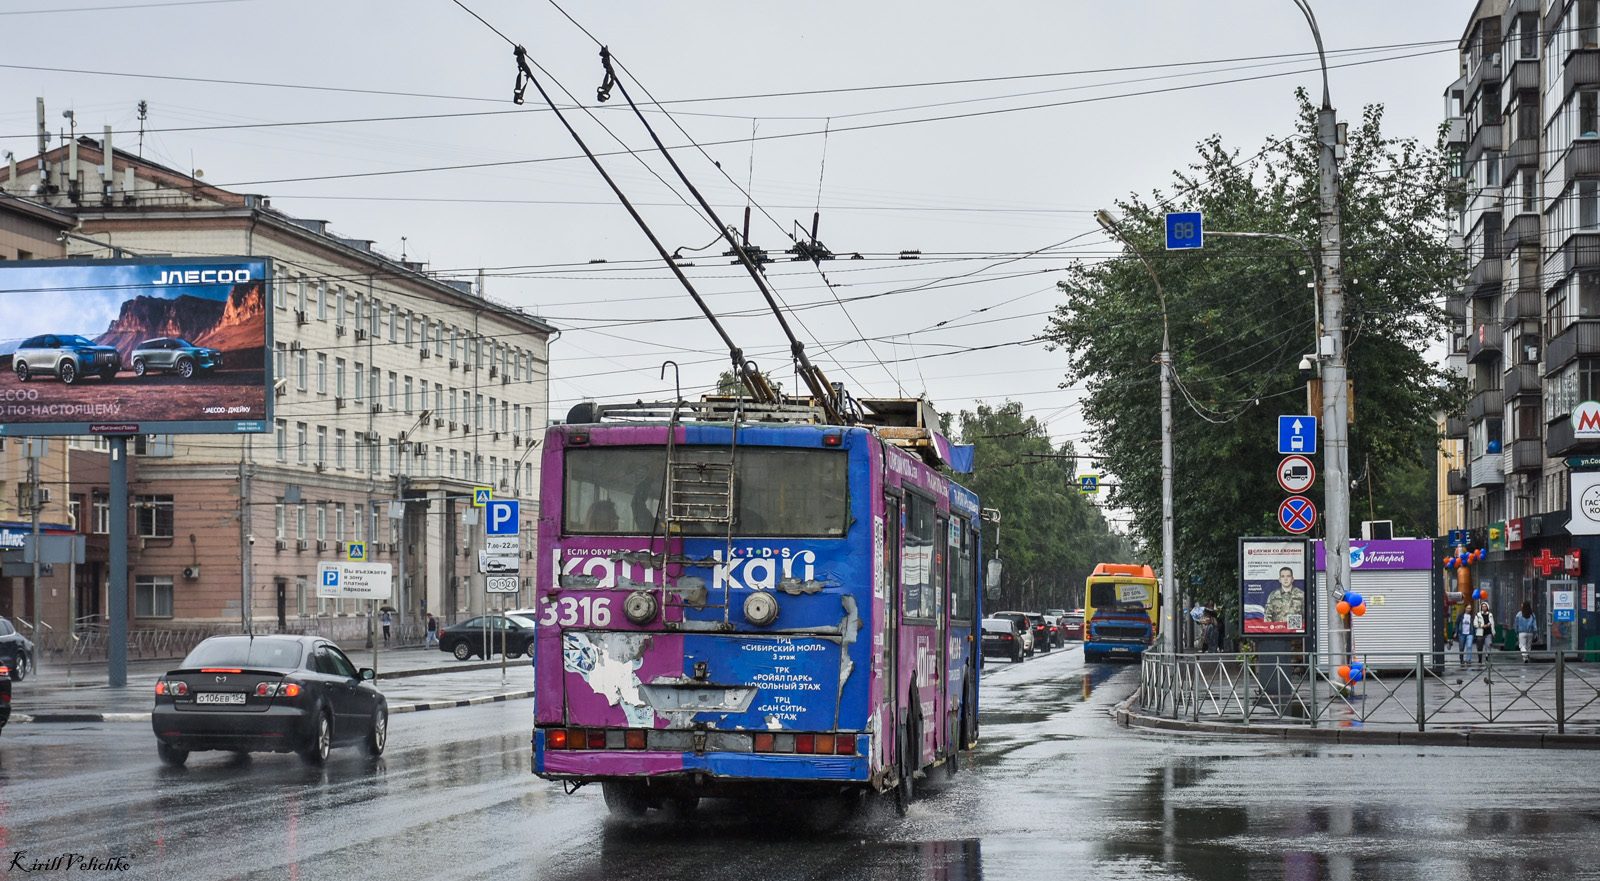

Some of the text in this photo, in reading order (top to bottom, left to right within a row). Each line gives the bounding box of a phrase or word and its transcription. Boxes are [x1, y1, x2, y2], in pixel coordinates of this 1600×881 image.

[152, 269, 250, 285] JAECOO
[8, 403, 121, 416] ПО-НАСТОЯЩЕМУ
[1365, 551, 1405, 565] Лотерея
[713, 549, 816, 590] kari
[539, 596, 611, 627] 3316
[742, 644, 795, 652] «СИБИРСКИЙ
[774, 666, 790, 674] ТРК
[753, 674, 785, 682] «РОЙЯЛ
[799, 683, 821, 691] ЭТАЖ
[774, 696, 791, 704] ТРЦ
[758, 704, 807, 712] «САН СИТИ»
[775, 713, 797, 721] ЭТАЖ
